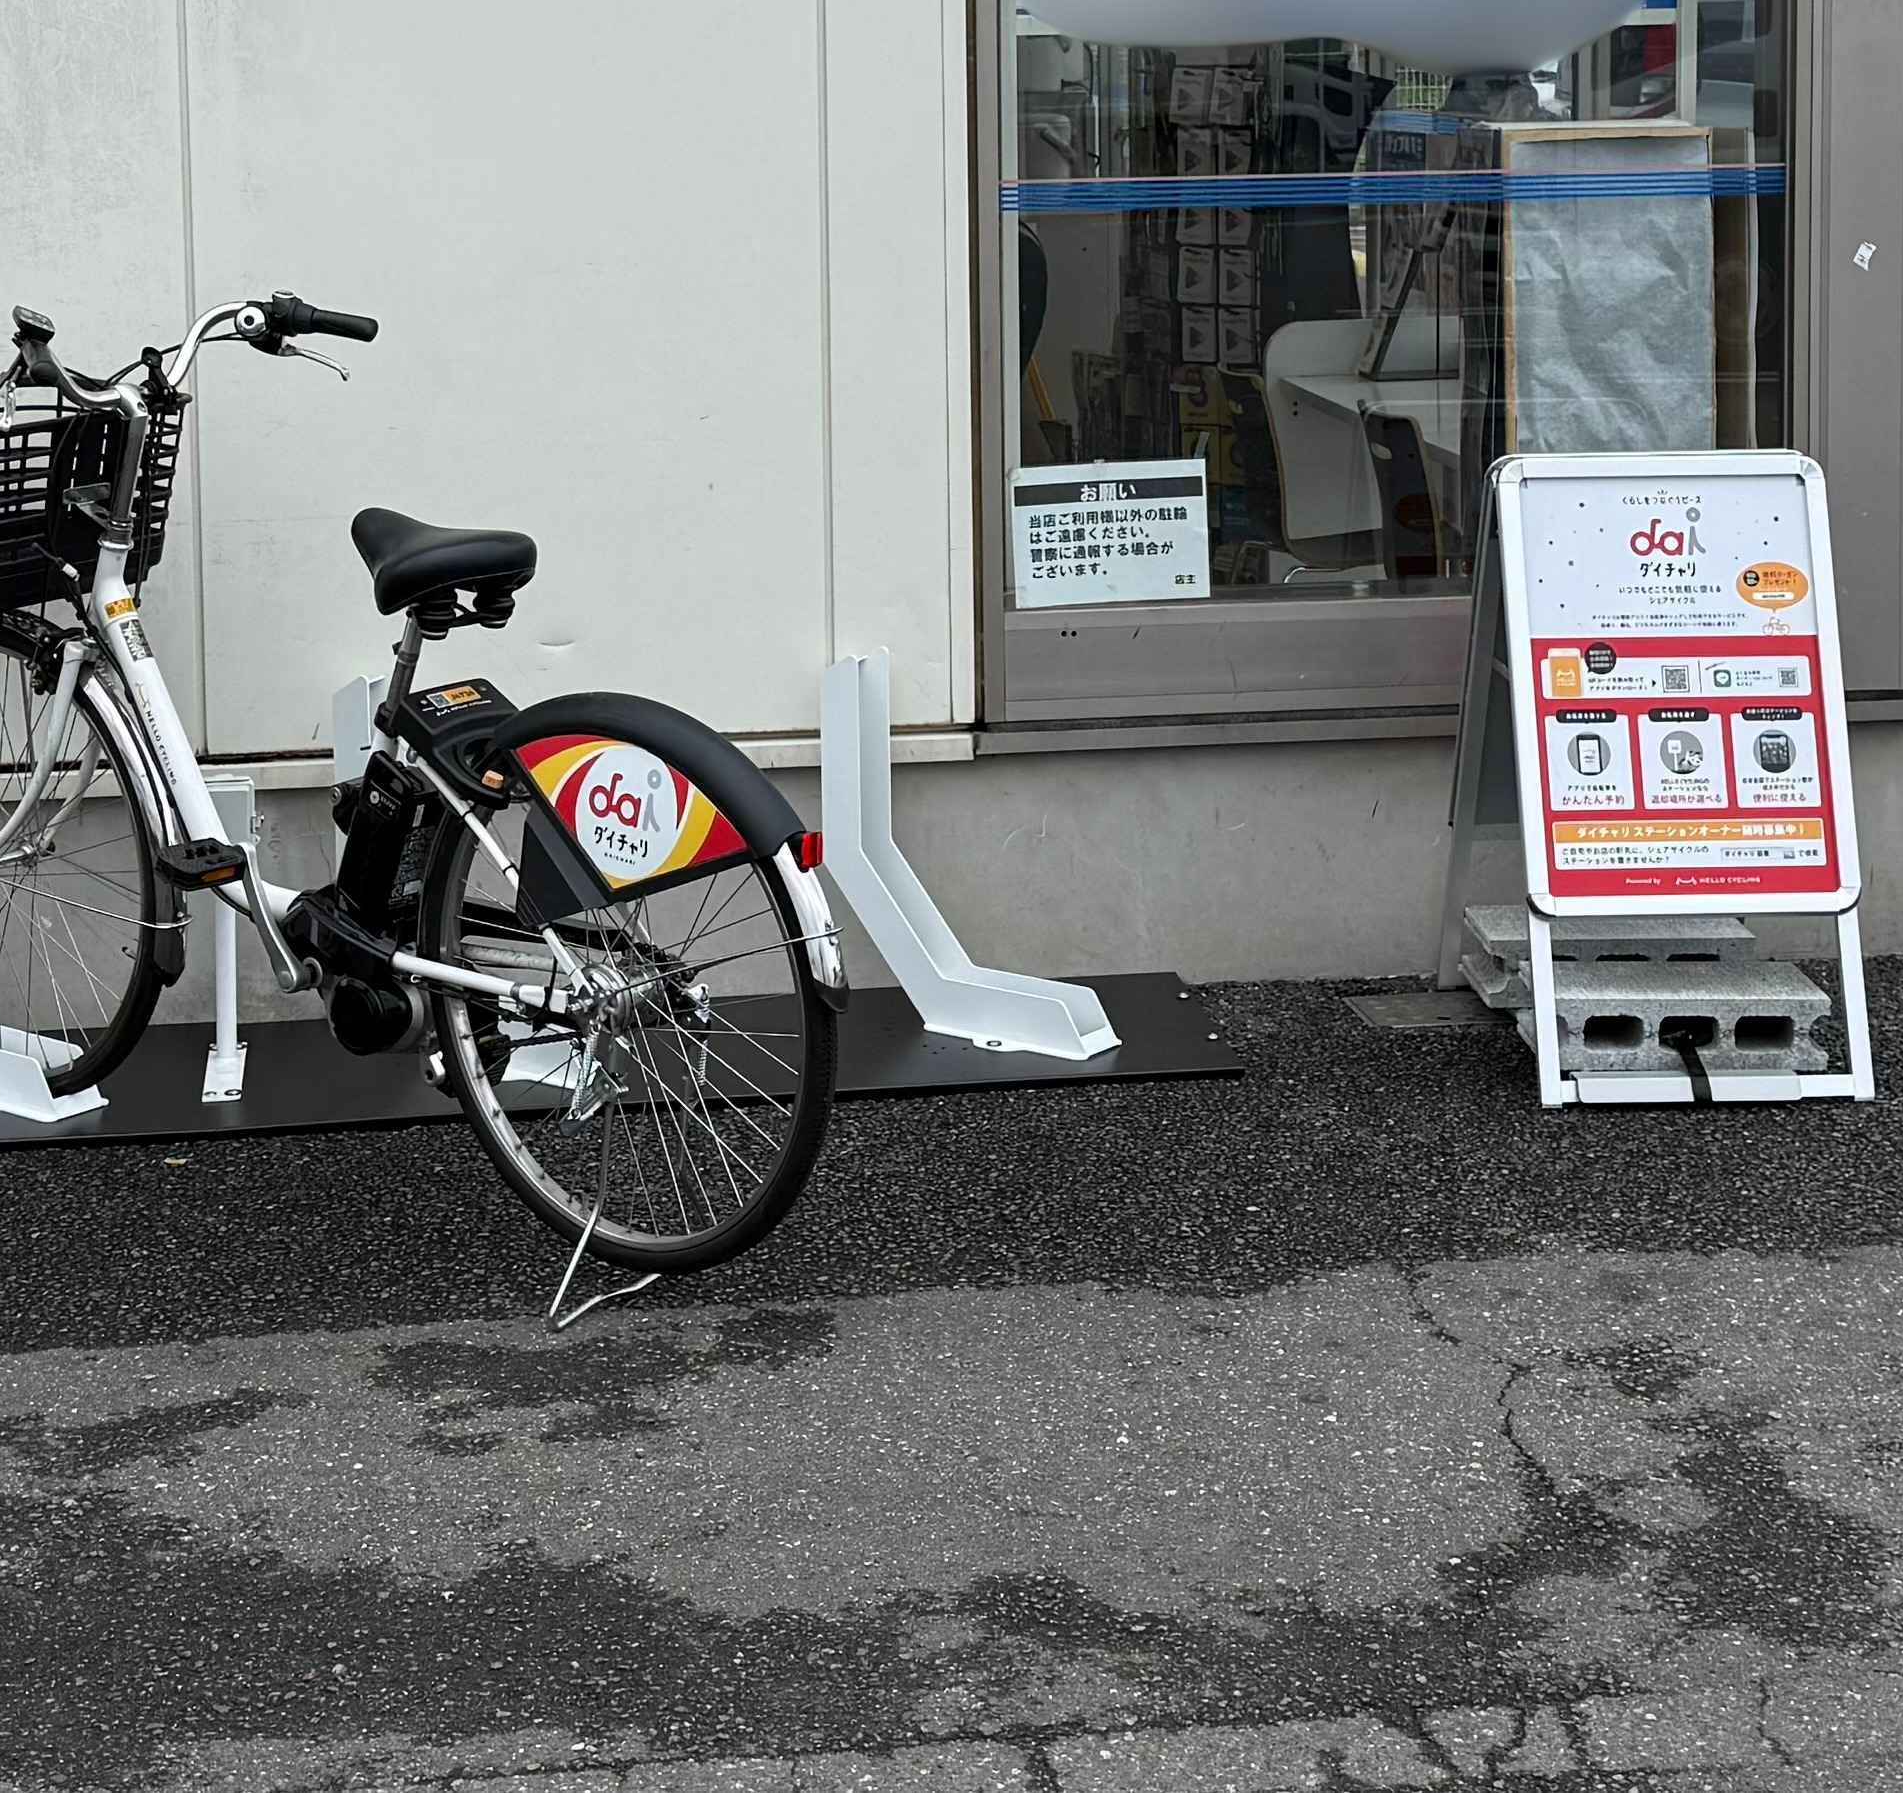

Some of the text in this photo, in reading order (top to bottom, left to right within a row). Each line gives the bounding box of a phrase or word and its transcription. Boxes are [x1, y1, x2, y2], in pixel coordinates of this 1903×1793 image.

[1080, 483, 1137, 502] お願い
[1630, 507, 1707, 556] dai
[1030, 541, 1174, 563] 警察に通報する場合が
[1032, 562, 1108, 579] ございます。
[1639, 562, 1697, 578] ダイチャリ
[1174, 574, 1197, 585] 店主
[589, 769, 662, 833] dai
[1562, 793, 1625, 806] かんたん予約
[1651, 793, 1722, 805] 返却場所が選べる
[1753, 792, 1807, 804] 便利に使える
[594, 826, 648, 858] ダイチャリ
